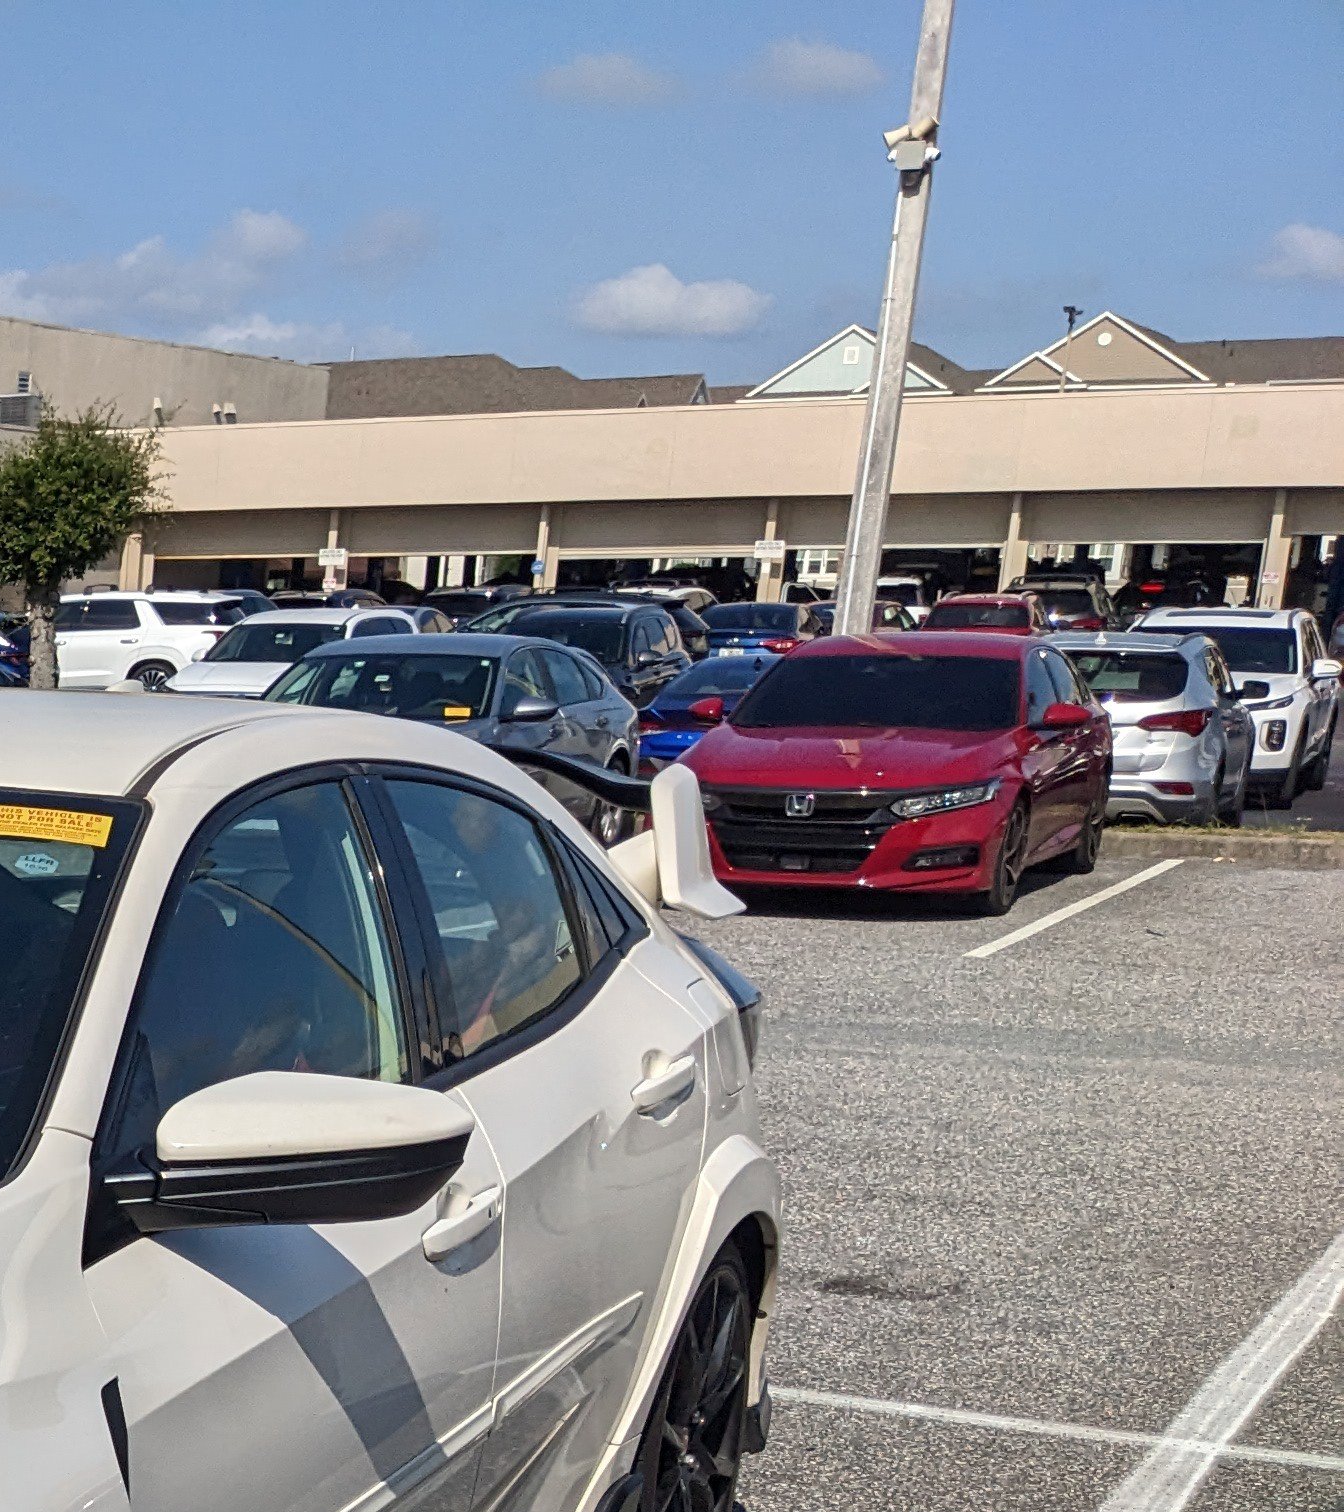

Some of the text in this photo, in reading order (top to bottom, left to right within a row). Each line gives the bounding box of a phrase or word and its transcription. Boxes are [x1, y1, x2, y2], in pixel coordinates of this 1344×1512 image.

[28, 809, 84, 820] VEHICLE
[28, 815, 54, 823] FOR
[59, 818, 94, 828] SALE
